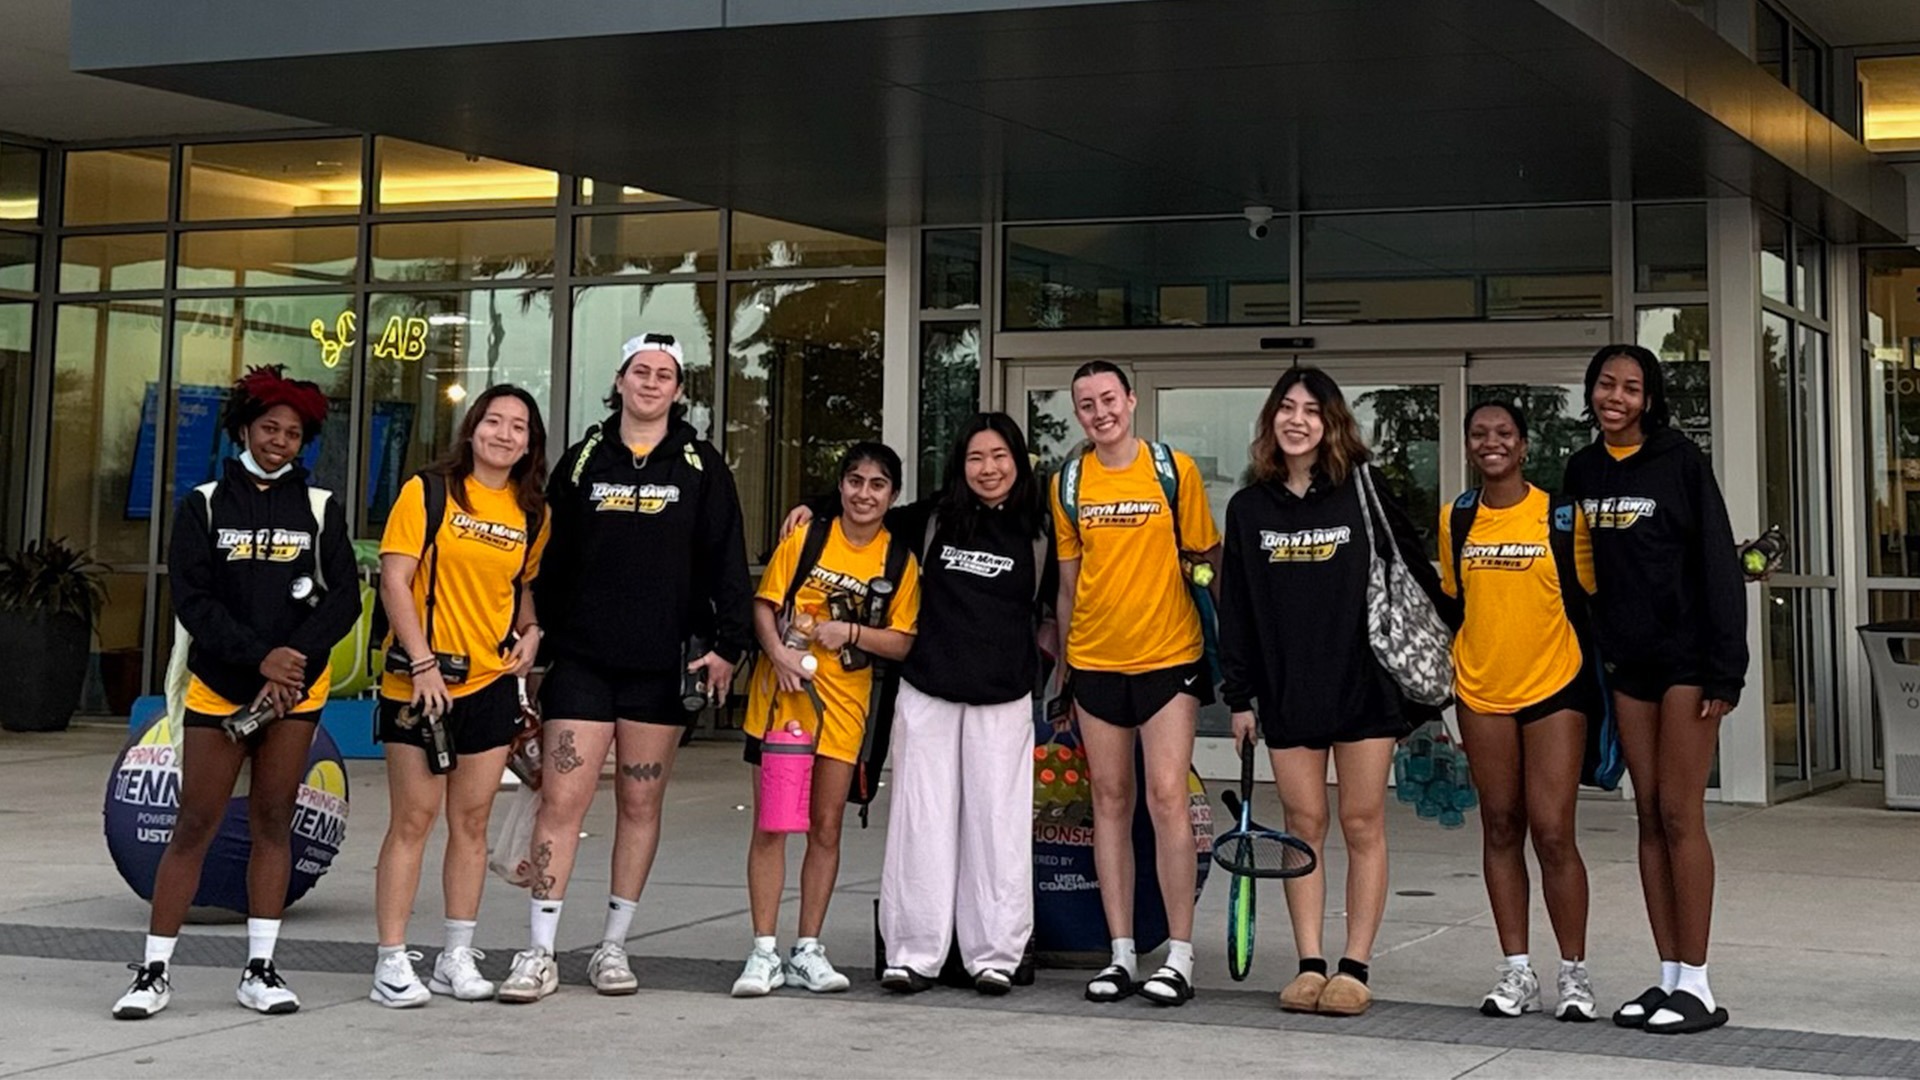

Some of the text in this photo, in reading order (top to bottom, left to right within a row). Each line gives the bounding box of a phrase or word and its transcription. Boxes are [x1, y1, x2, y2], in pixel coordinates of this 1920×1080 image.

[373, 315, 428, 360] AB
[1081, 501, 1161, 518] BRYN MAWR
[452, 513, 526, 542] BRYN MAWR
[1463, 543, 1546, 558] BRYN MAWR
[1480, 559, 1522, 567] TENNIS
[124, 746, 172, 767] SPRING
[1033, 824, 1094, 846] IONSH
[1053, 873, 1086, 884] USTA
